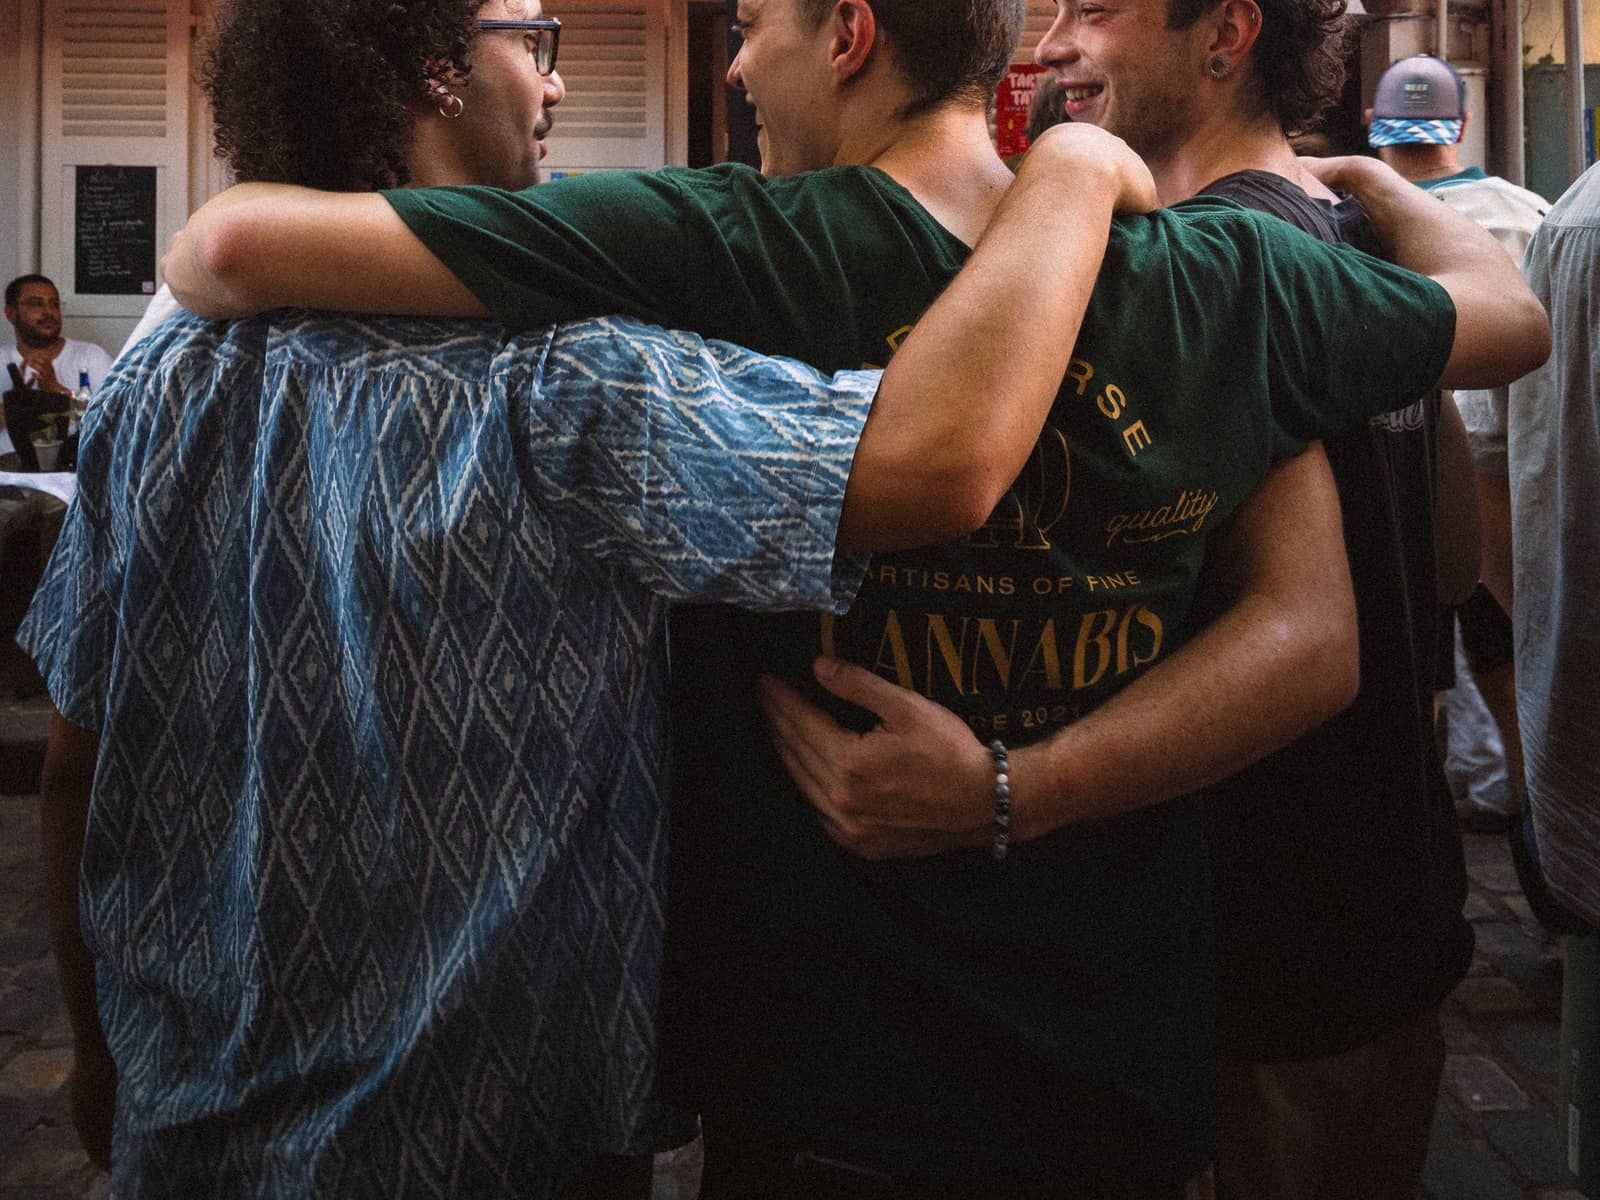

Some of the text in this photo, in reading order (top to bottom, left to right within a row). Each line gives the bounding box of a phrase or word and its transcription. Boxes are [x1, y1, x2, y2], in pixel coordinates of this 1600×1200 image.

[1106, 488, 1219, 547] quality
[867, 563, 1141, 596] RTISANS OF FINE
